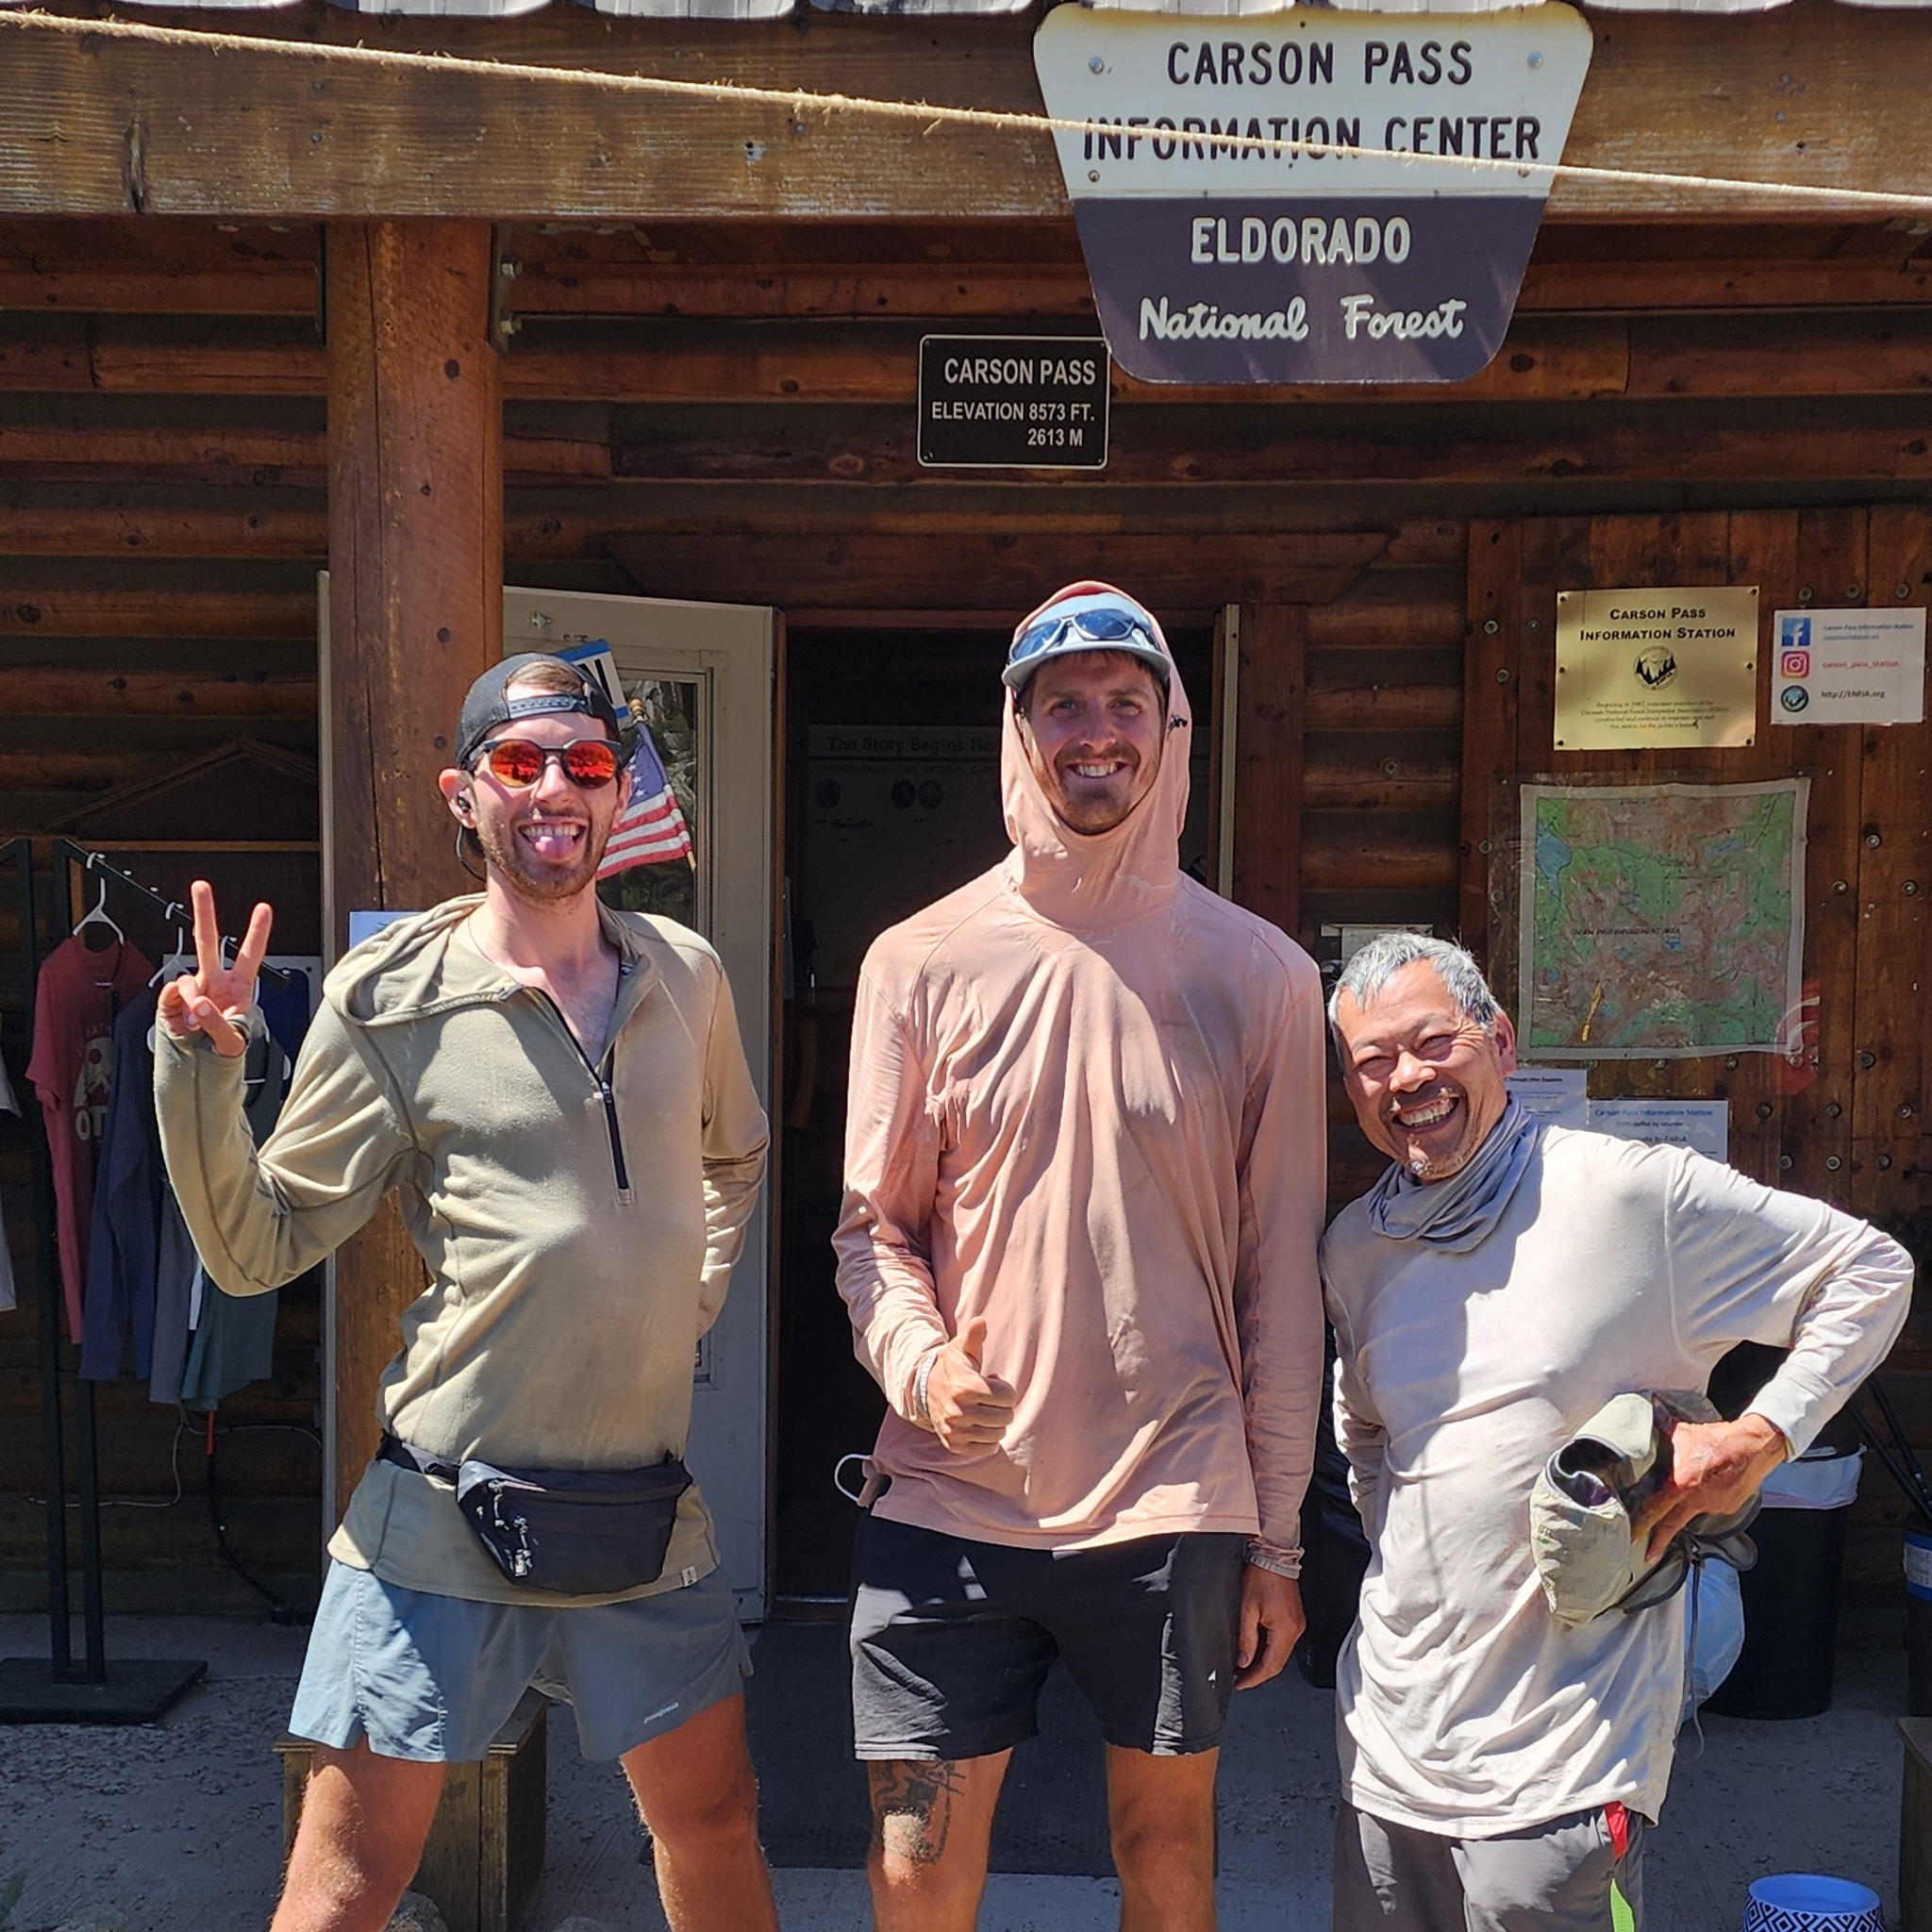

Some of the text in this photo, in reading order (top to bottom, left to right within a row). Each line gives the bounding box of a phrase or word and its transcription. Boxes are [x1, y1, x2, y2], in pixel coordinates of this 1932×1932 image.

[1167, 41, 1474, 86] CARSON PASS
[1084, 115, 1541, 159] INFORMATION CENTER
[1191, 216, 1412, 264] ELDORADO
[1139, 291, 1467, 342] National Forest
[943, 358, 1096, 386] CARSON PASS
[931, 401, 1095, 422] ELEVATION 8573 FT.
[1027, 428, 1083, 447] 2613 M
